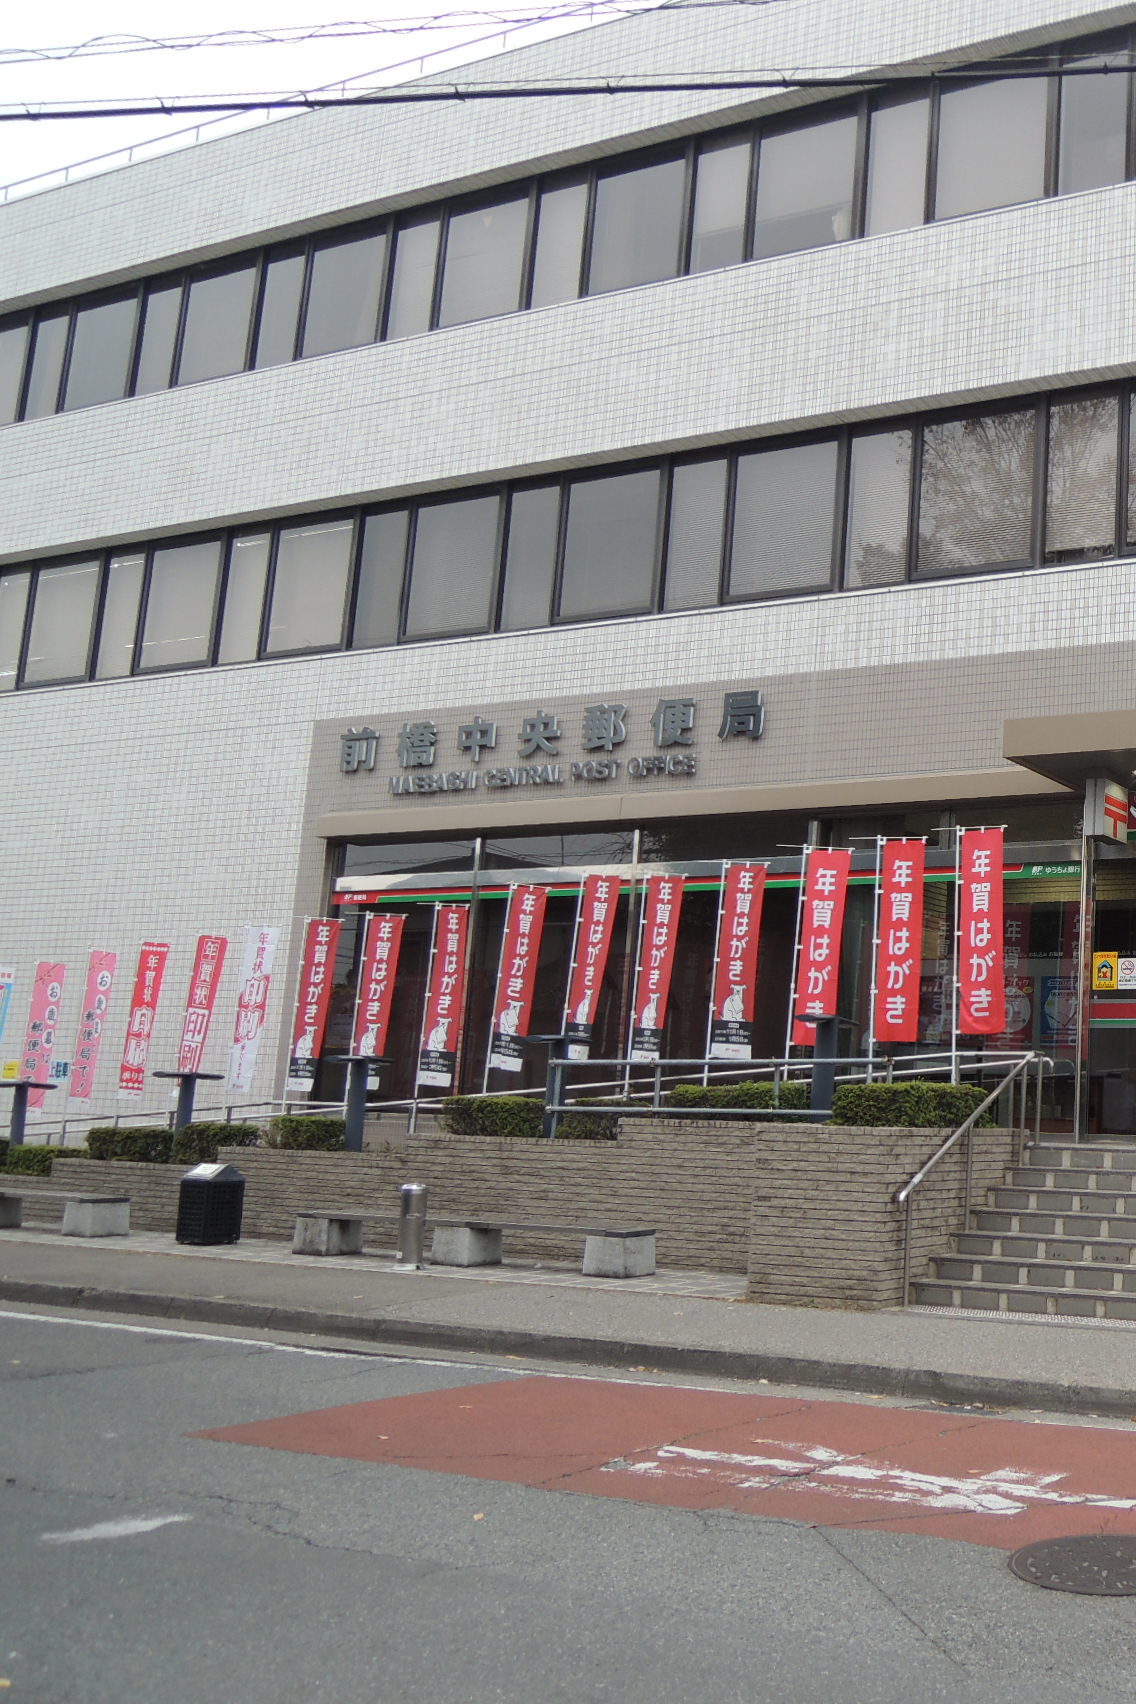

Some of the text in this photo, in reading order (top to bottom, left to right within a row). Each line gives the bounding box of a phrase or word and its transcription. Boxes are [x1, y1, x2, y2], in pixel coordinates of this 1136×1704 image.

[339, 689, 766, 773] 前橋中央郵便局
[388, 753, 697, 795] MAEBASHI CENTRAL POST OFFICE
[1045, 865, 1081, 874] ゆうちょ銀行
[304, 925, 330, 1023] 年賀はがき
[366, 921, 393, 1020] 年賀はがき
[437, 912, 459, 1015] 年賀はがき
[507, 893, 536, 998] 年賀はがき
[584, 880, 610, 986] 年賀はがき
[648, 881, 673, 989] 年賀はがき
[728, 871, 754, 981] 年賀はがき
[885, 859, 914, 1024] 年賀はがき
[969, 849, 996, 1017] 年賀はがき
